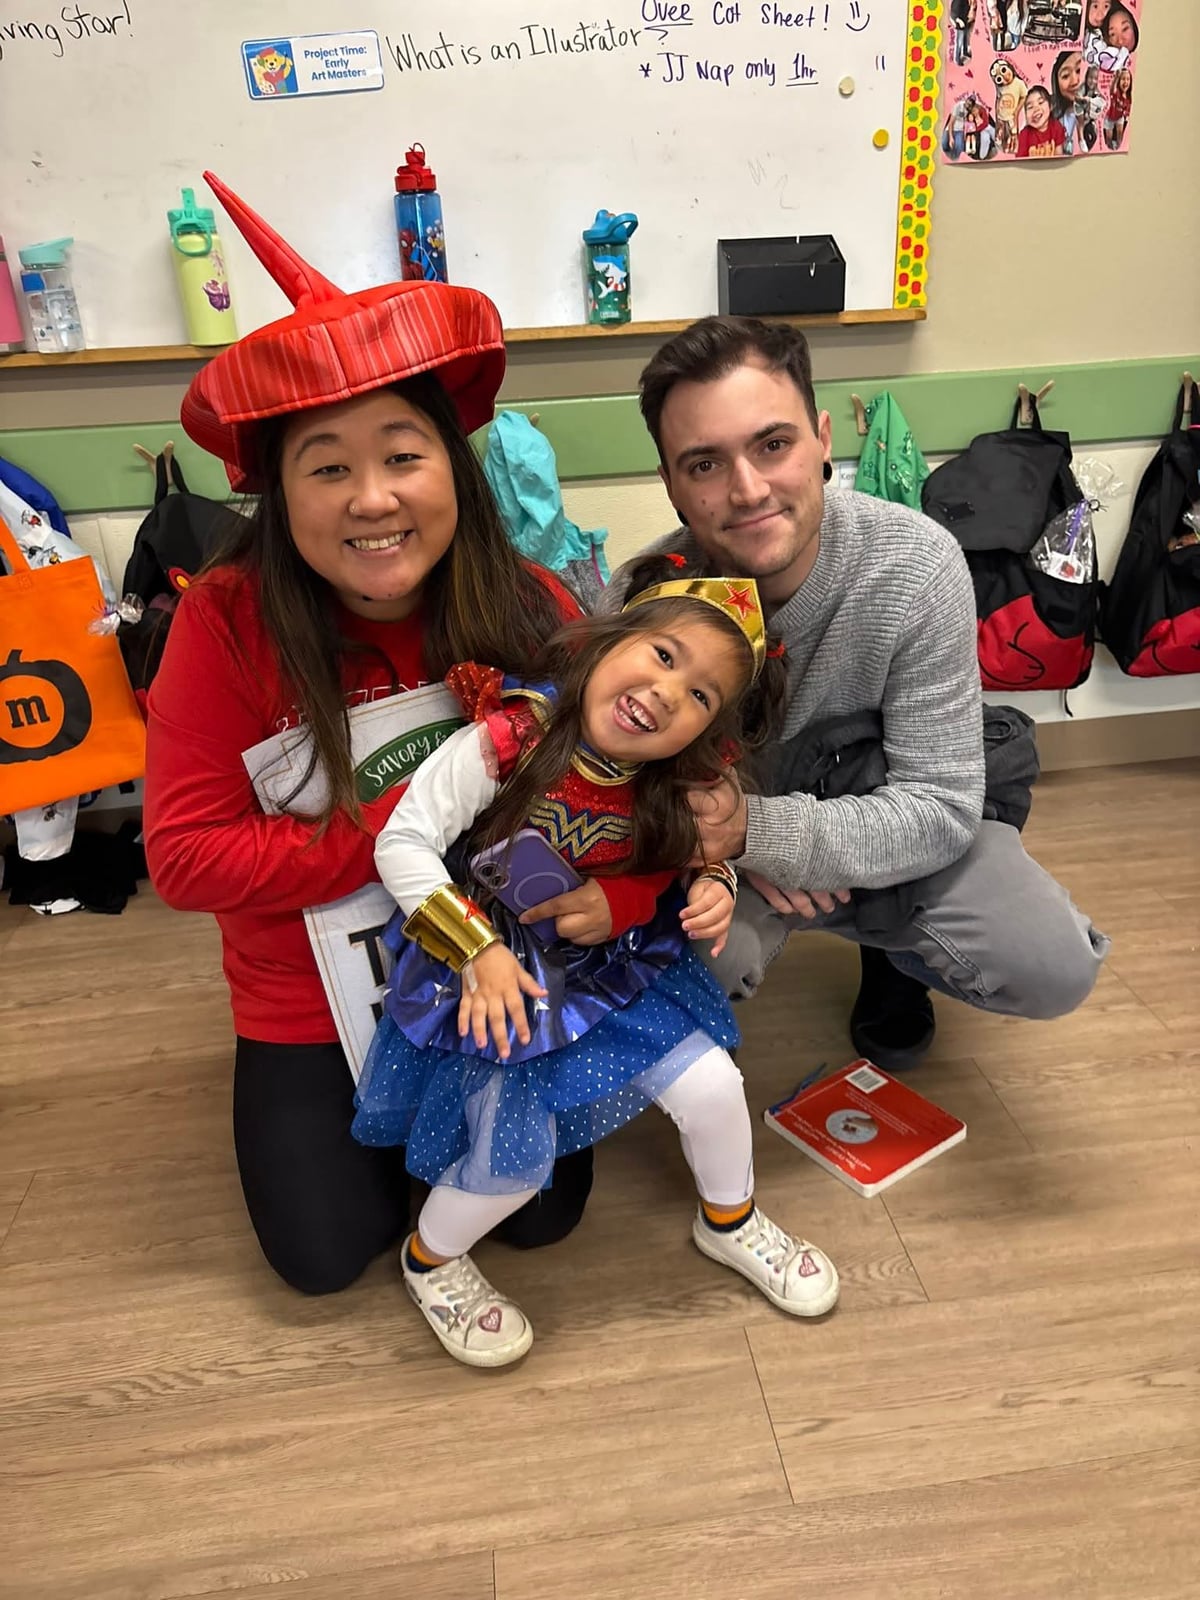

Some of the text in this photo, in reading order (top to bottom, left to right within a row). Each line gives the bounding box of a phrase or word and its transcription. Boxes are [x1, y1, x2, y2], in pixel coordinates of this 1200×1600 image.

[61, 0, 134, 39] Star!
[712, 1, 742, 25] Cot
[304, 45, 368, 60] Project Time:
[324, 58, 350, 69] Early
[385, 32, 454, 72] What
[460, 46, 482, 65] is
[490, 43, 521, 60] an
[311, 68, 367, 81] Art Masters
[656, 52, 818, 87] JJ Nap only 1hr
[5, 695, 50, 728] m
